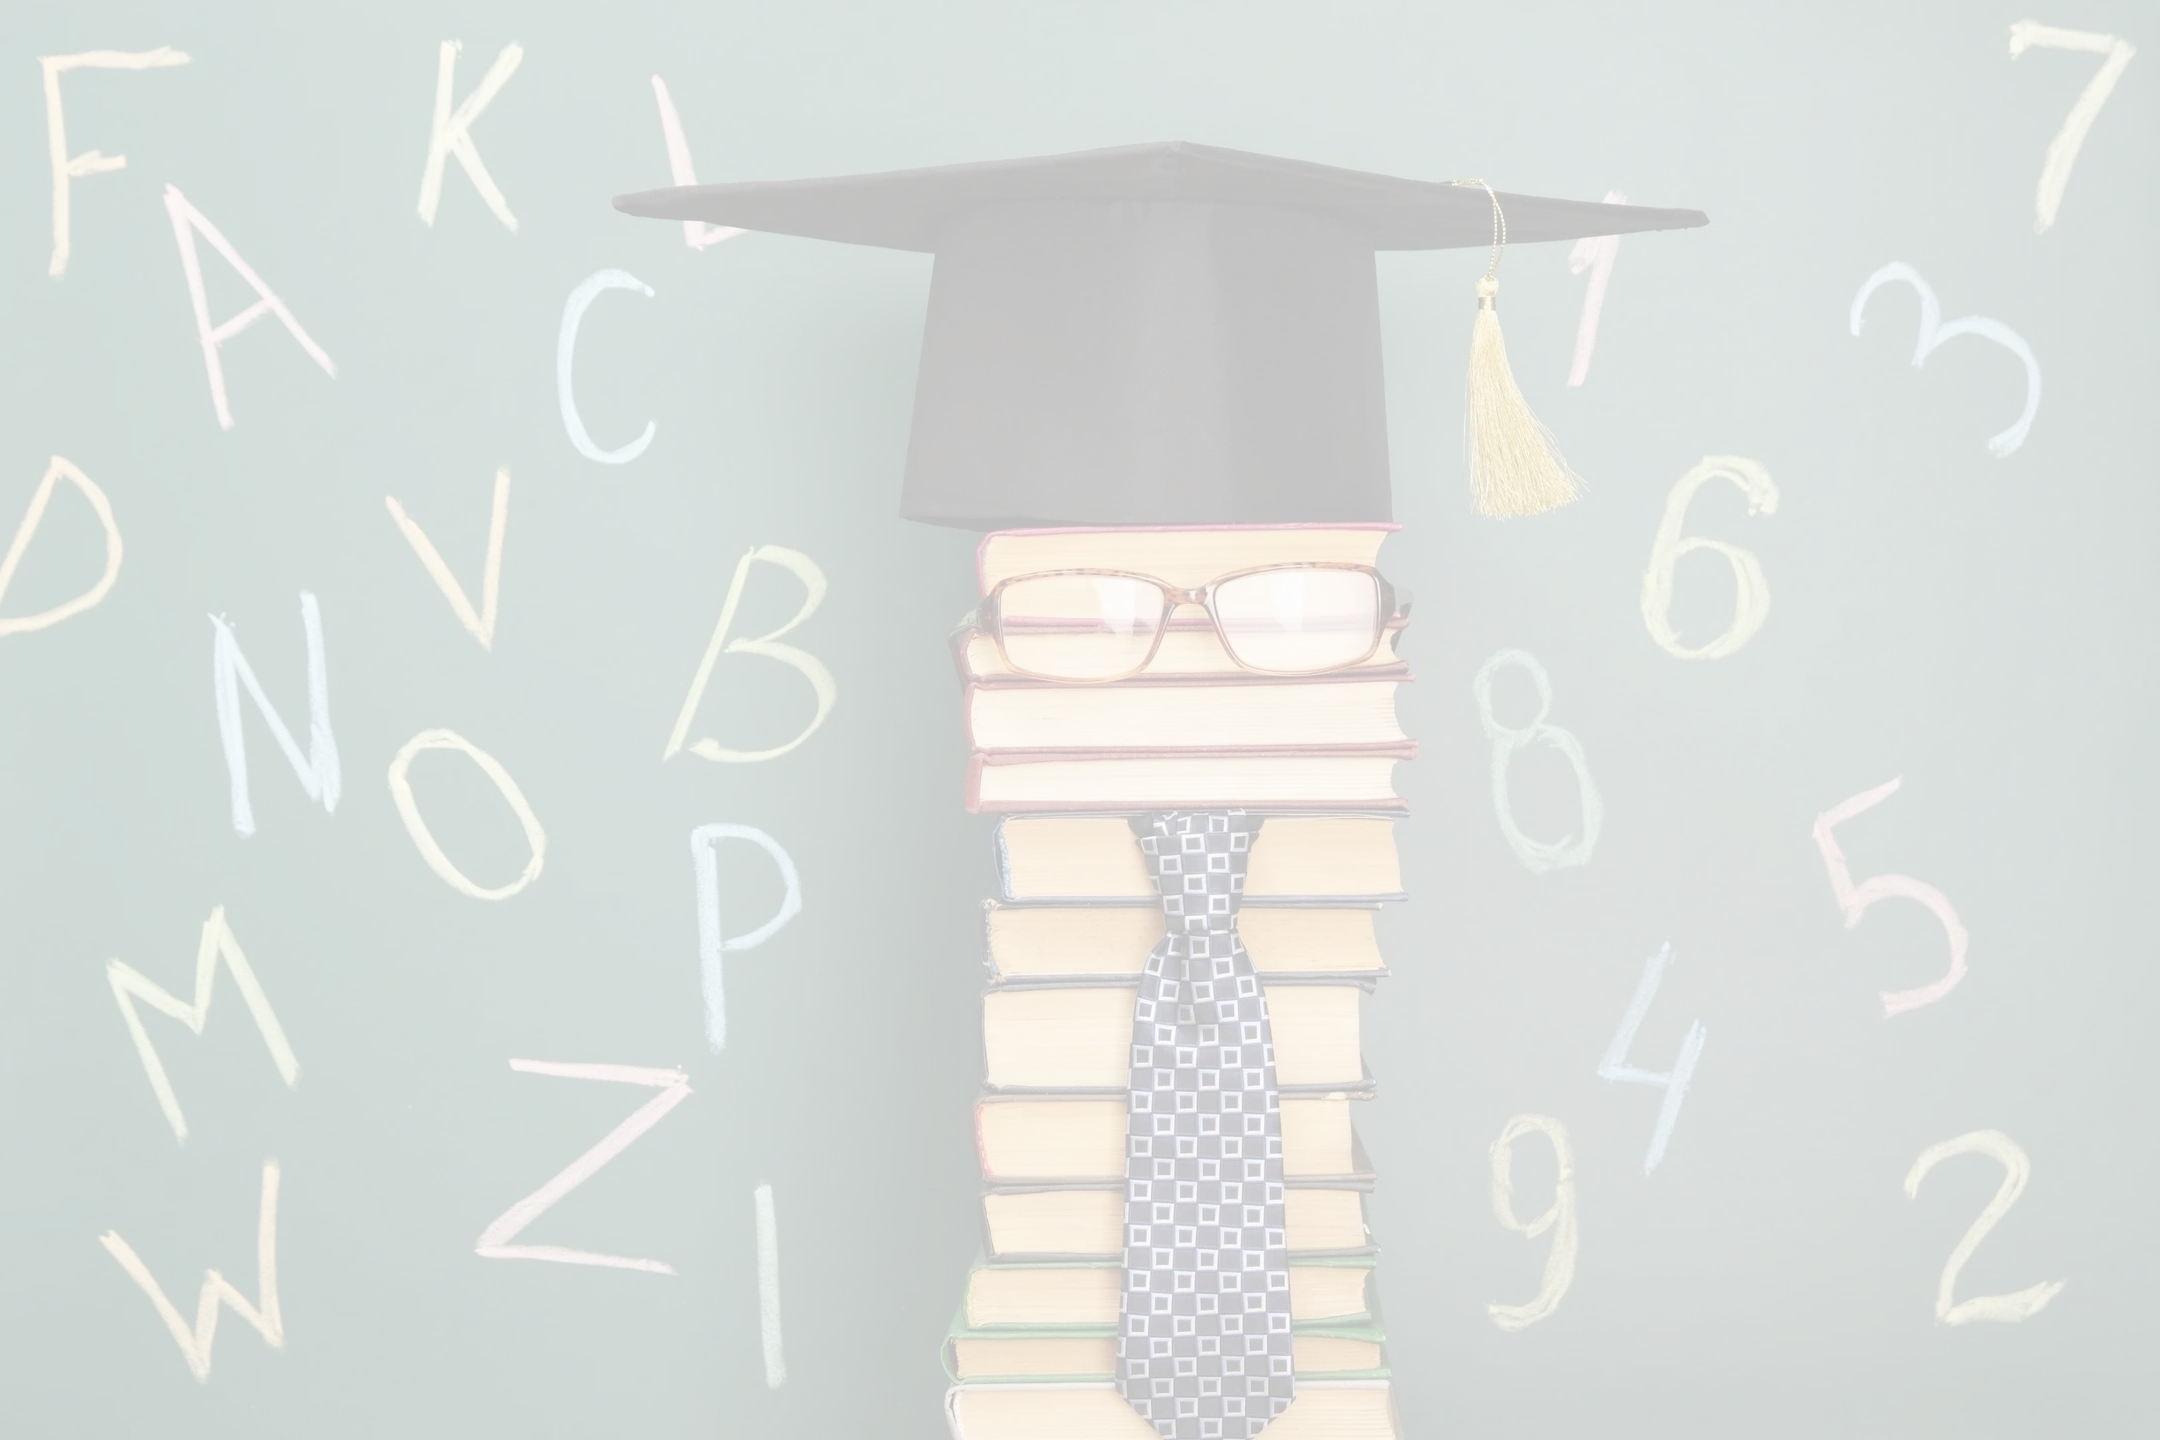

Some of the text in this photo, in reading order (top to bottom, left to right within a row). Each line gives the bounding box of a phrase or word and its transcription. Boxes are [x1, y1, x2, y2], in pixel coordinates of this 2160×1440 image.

[37, 45, 193, 281] F
[417, 39, 524, 233] K
[651, 73, 752, 251] L
[2009, 19, 2136, 234] 7
[163, 183, 335, 430] A
[557, 268, 657, 464] C
[1567, 188, 1628, 386] 1
[1850, 261, 2042, 458] 3
[0, 455, 123, 637] D
[385, 467, 511, 652] V
[663, 544, 836, 763] B
[1640, 455, 1779, 659] 6
[207, 589, 342, 839] N
[388, 728, 548, 901] O
[1473, 648, 1603, 874] 8
[690, 823, 802, 1055] P
[1812, 776, 1968, 1018] 5
[106, 904, 301, 1146] M
[1597, 941, 1706, 1176] 4
[99, 1159, 284, 1384] W
[474, 1058, 694, 1275] Z
[1487, 1114, 1578, 1332] 9
[1904, 1129, 2065, 1326] 2
